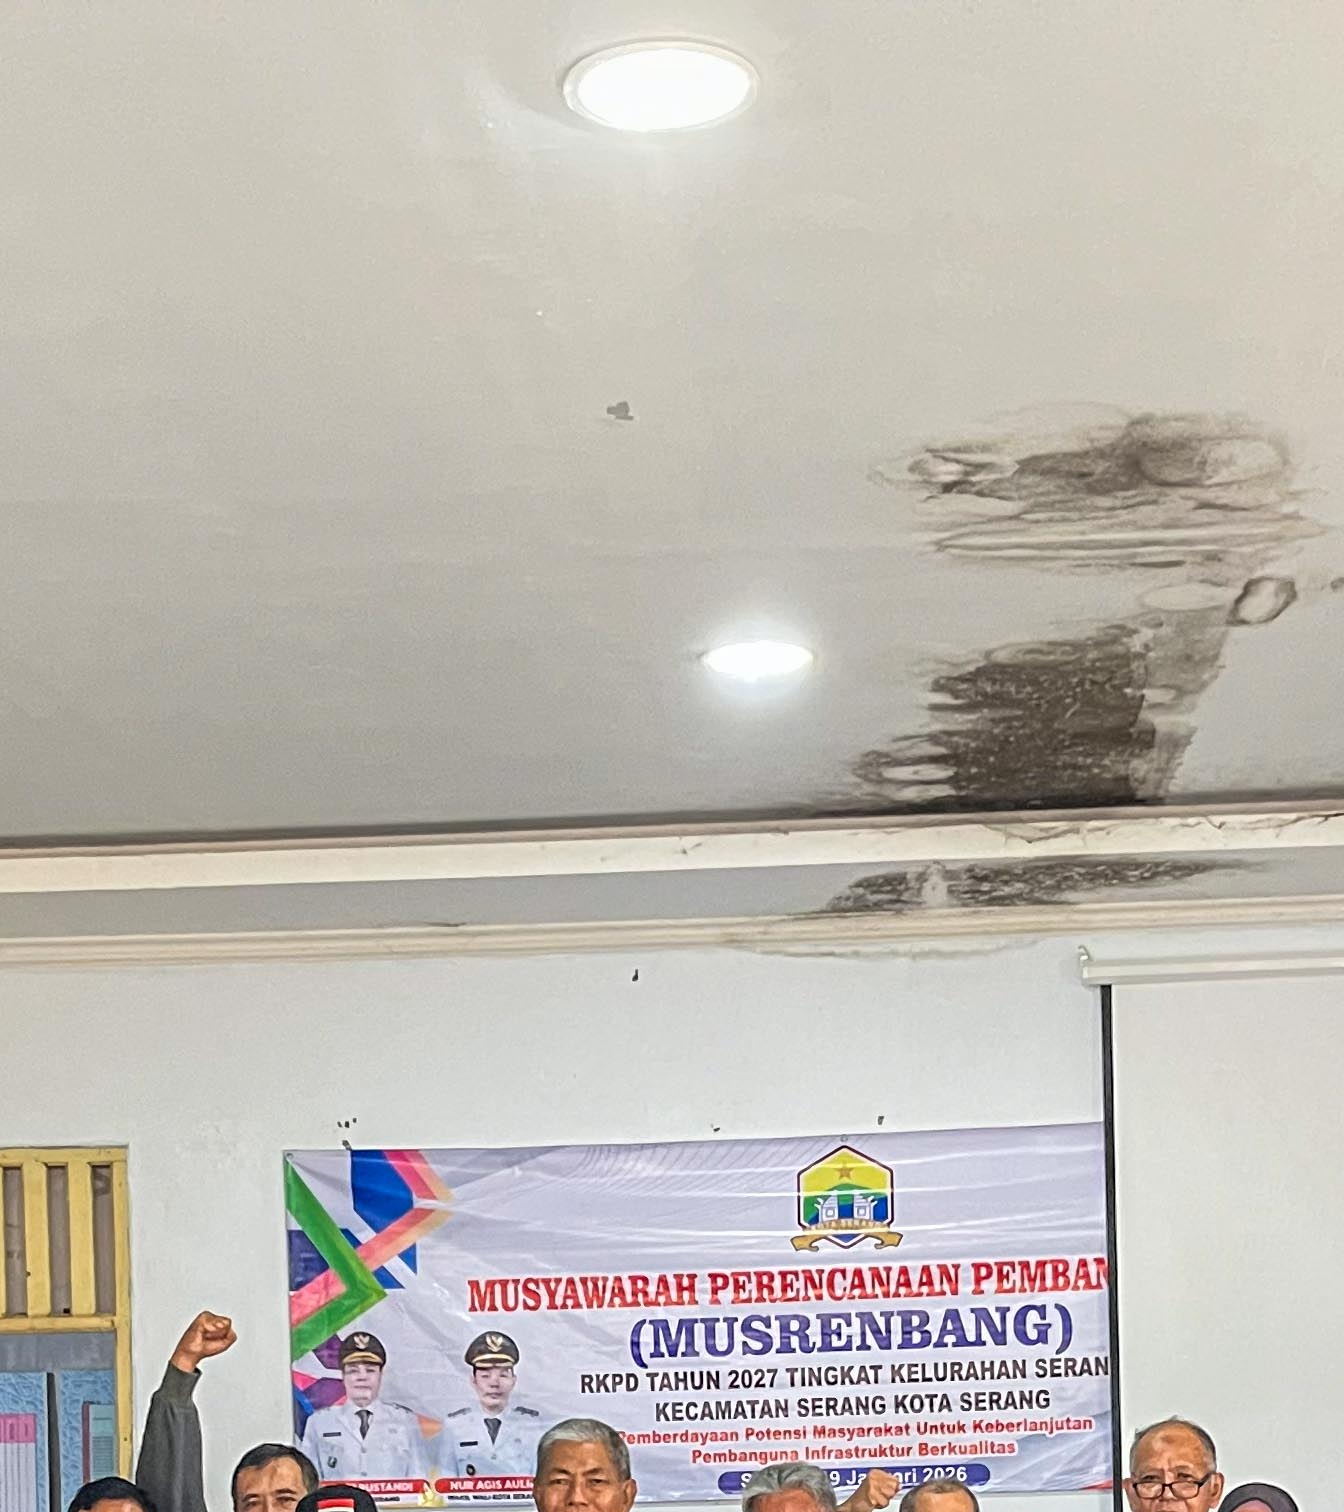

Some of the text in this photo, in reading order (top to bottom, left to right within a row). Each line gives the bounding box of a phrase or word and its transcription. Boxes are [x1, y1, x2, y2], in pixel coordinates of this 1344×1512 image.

[467, 1272, 700, 1313] MUSYAWARAH
[707, 1262, 961, 1305] PERENCANAAN
[630, 1303, 1073, 1369] (MUSRENBANG)
[580, 1356, 1109, 1393] RKPD TAHUN 2027 TINGKAT KELURAHAN SERAN
[655, 1389, 1051, 1422] KECAMATAN SERANG KOTA SERANG
[745, 1425, 807, 1442] Potensi
[813, 1421, 911, 1442] Masyarakat
[916, 1419, 966, 1436] Untuk
[972, 1416, 1093, 1435] Keberlanjutan
[692, 1440, 1017, 1465] Pembanguna Infrastruktur Berkualitas
[450, 1480, 474, 1490] NUR
[476, 1479, 503, 1490] AGIS
[504, 1479, 534, 1489] AULI
[845, 1467, 917, 1485] Jaari
[923, 1466, 968, 1484] 2026
